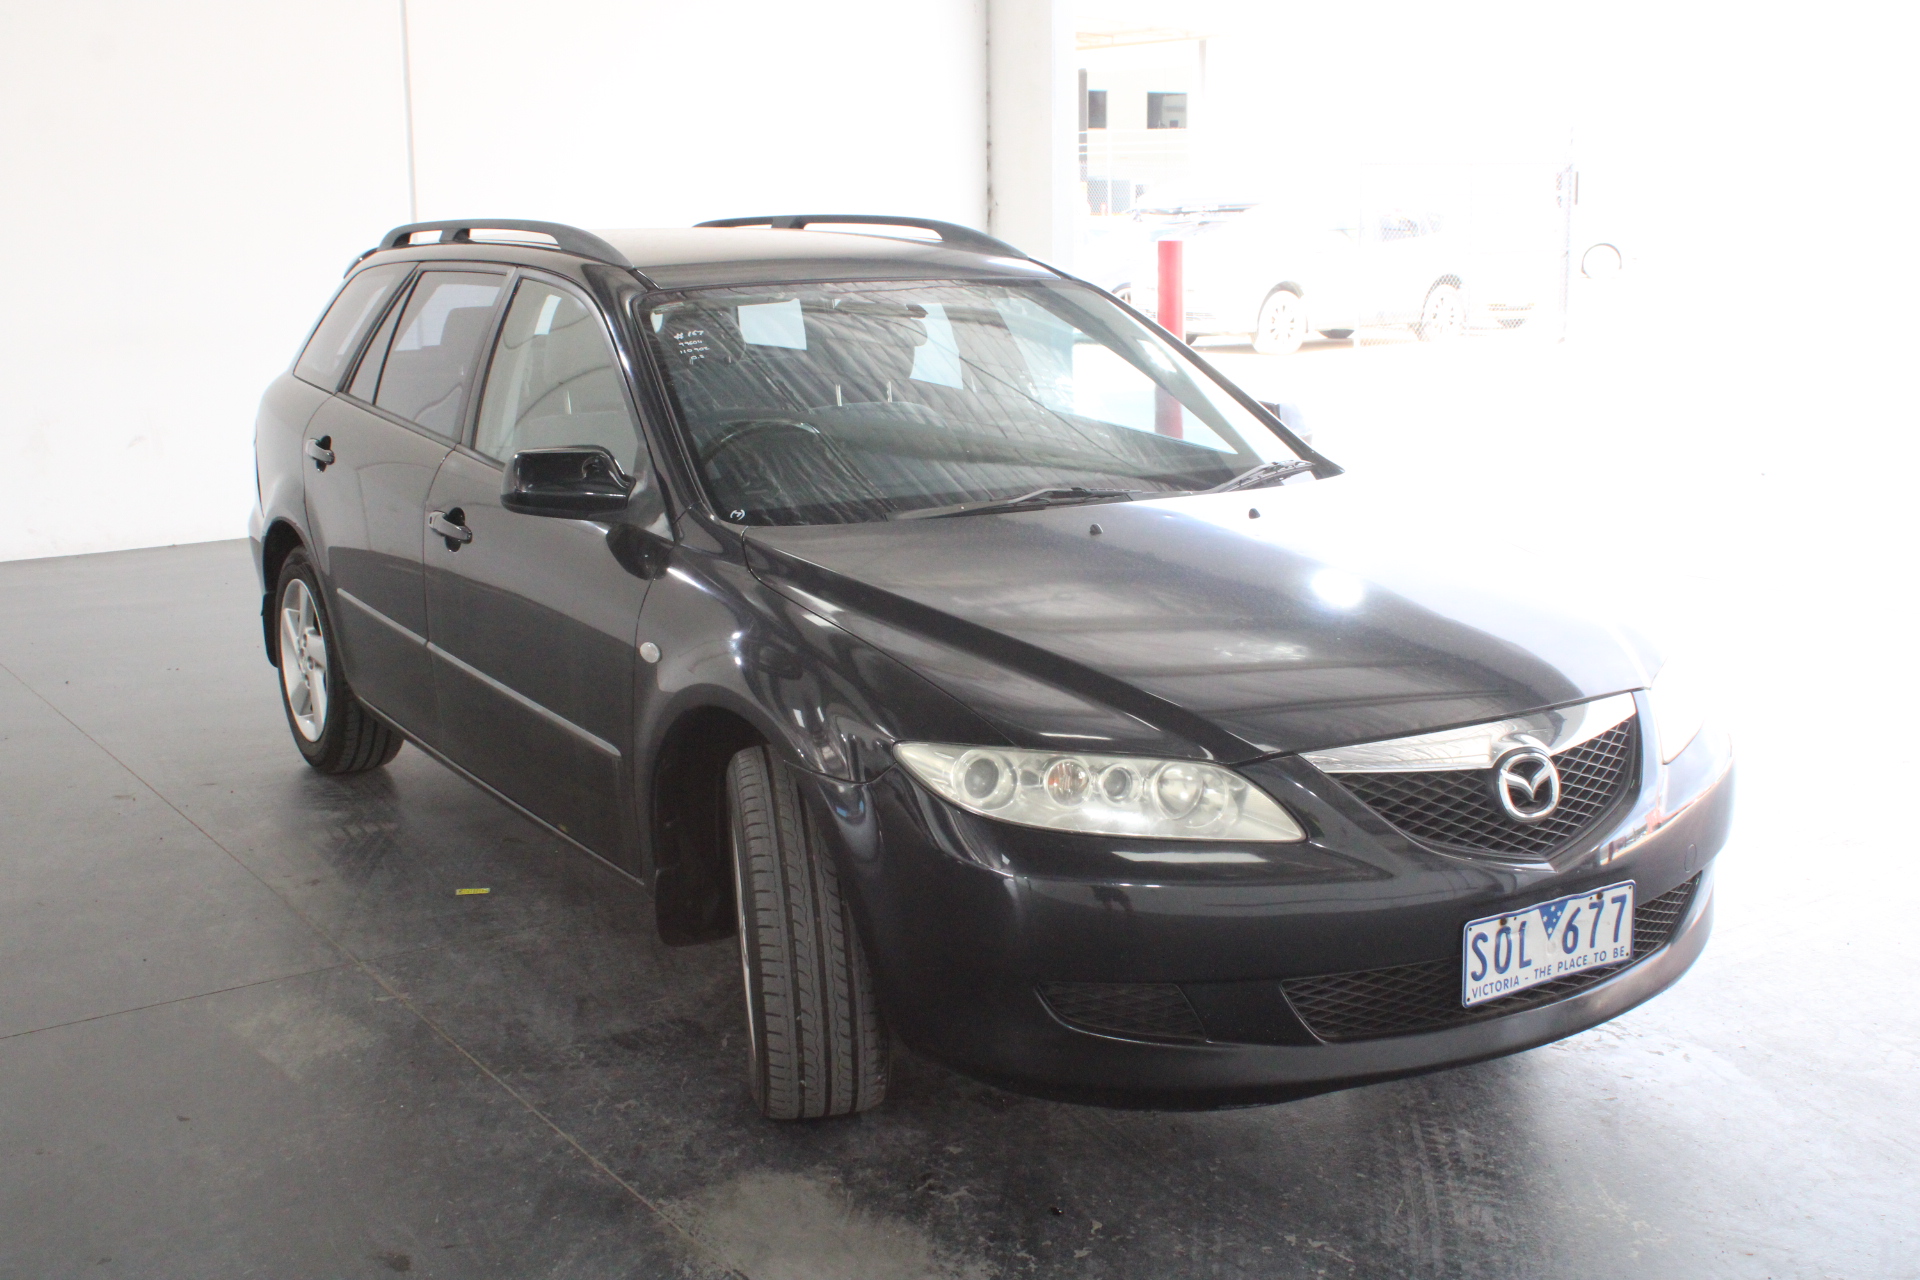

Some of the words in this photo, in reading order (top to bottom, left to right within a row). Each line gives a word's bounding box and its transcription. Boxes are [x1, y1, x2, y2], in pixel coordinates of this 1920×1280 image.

[1470, 920, 1532, 982] SOL
[1562, 894, 1627, 955] 677
[1472, 975, 1520, 999] VICTORIA
[1534, 963, 1553, 980] THE
[1557, 954, 1588, 972] PLACE
[1593, 951, 1607, 963] TO
[1613, 946, 1625, 959] BE
